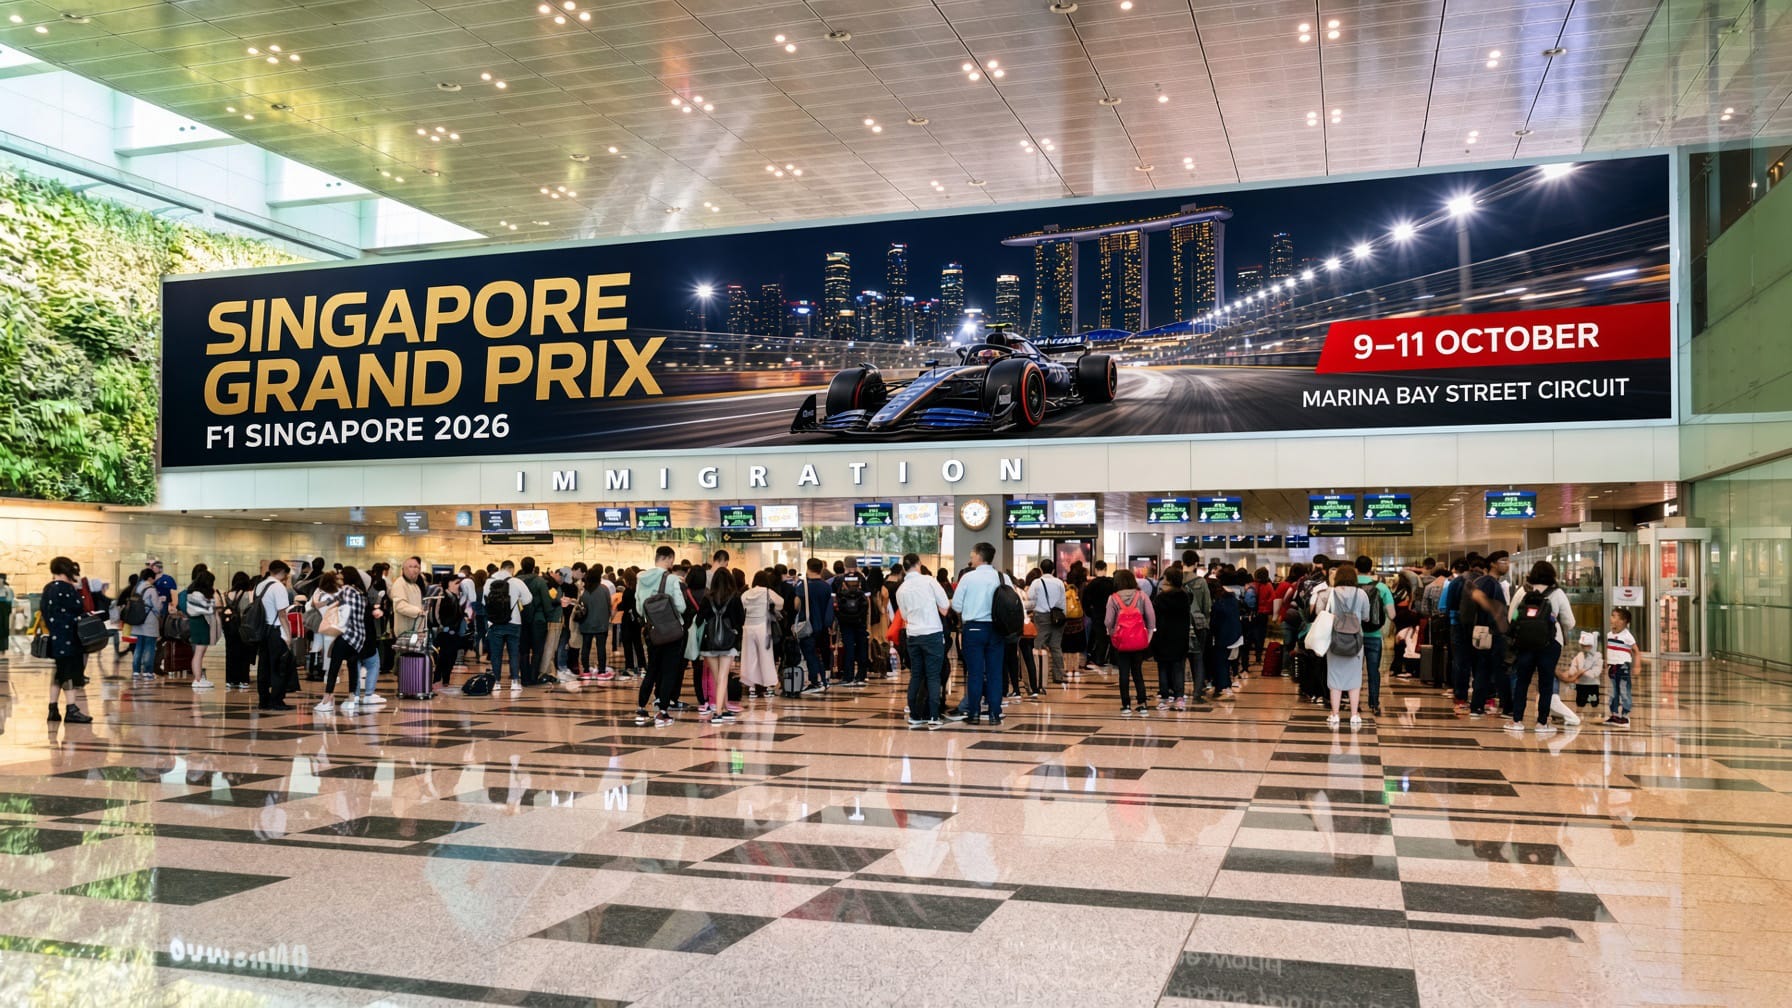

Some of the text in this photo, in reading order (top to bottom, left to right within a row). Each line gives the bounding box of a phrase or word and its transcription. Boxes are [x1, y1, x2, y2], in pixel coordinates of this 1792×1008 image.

[205, 272, 632, 356] SINGAPORE
[1435, 322, 1600, 355] OCTOBER
[204, 336, 667, 415] GRAND PRIX
[1302, 377, 1630, 408] MARINA BAY STREET CIRCUIT
[206, 413, 511, 449] F1 SINGAPORE 2026
[516, 457, 1024, 494] IMMIGRATION
